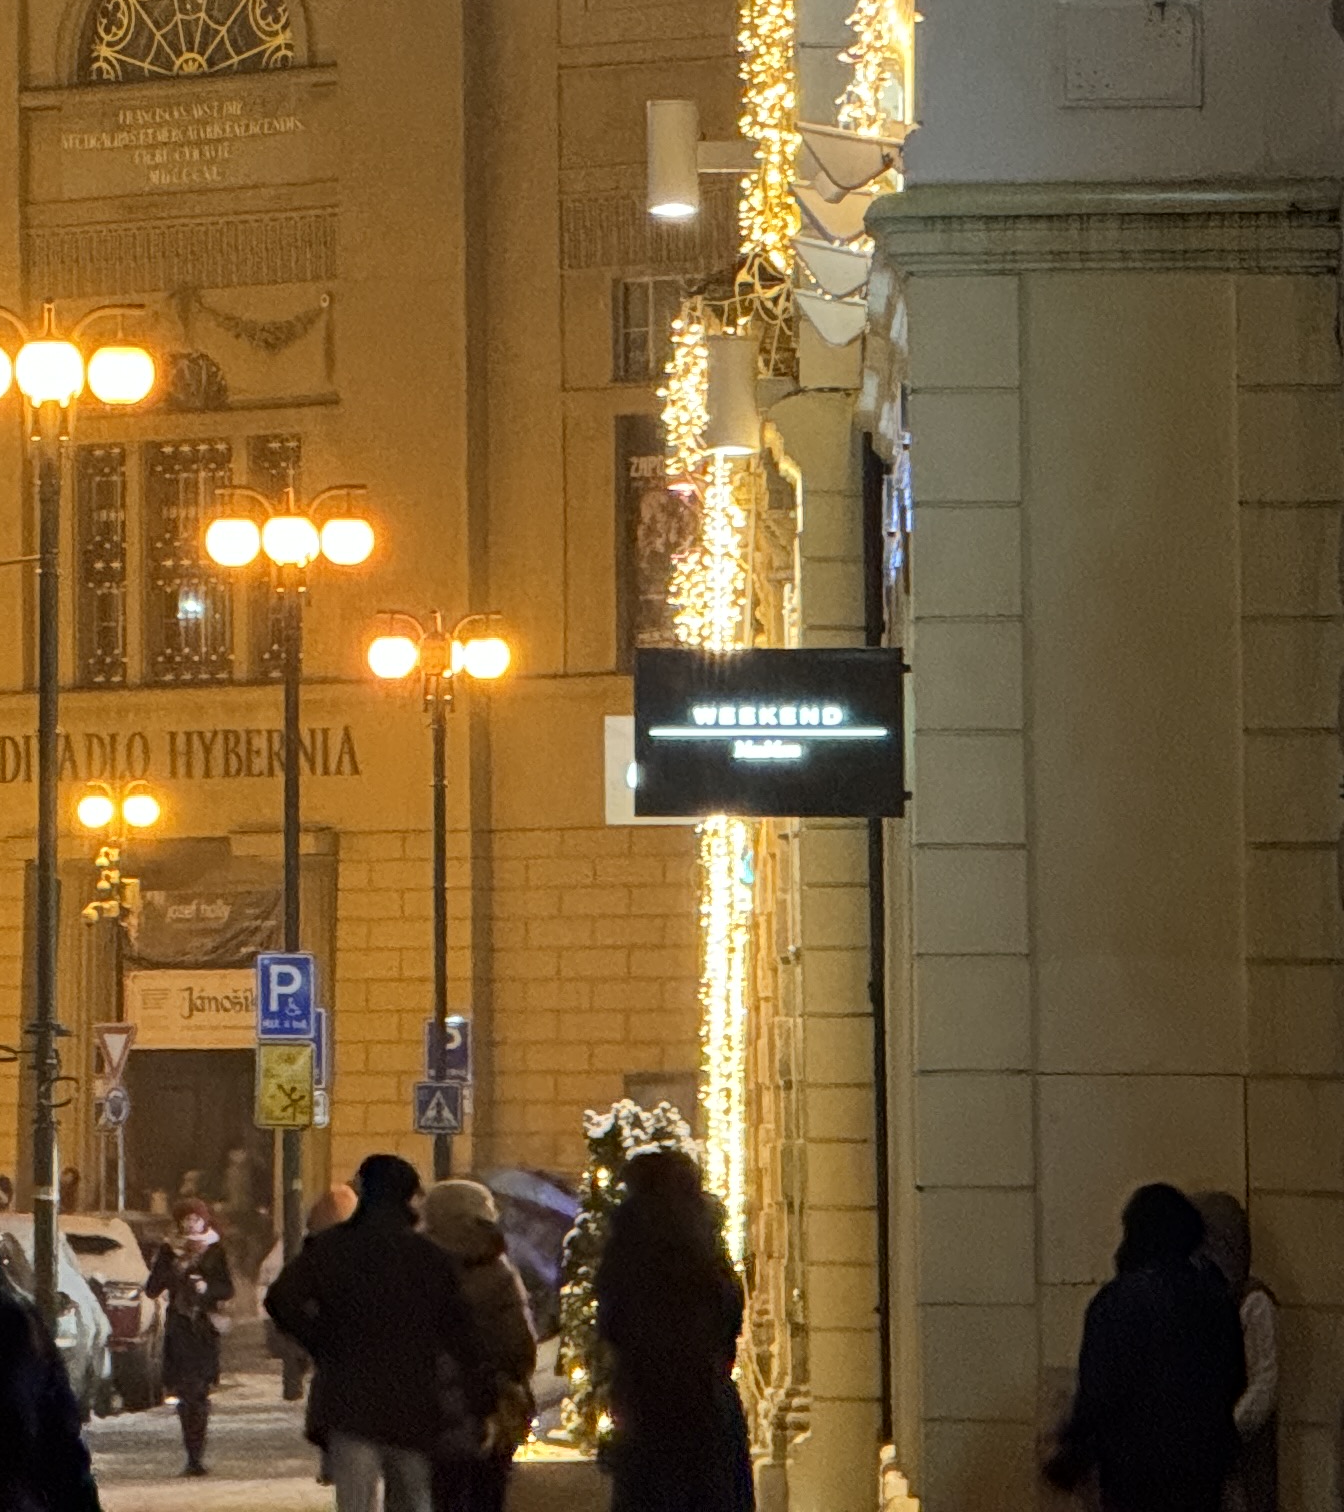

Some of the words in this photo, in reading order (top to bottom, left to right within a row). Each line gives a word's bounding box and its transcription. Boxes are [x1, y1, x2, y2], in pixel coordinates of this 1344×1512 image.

[692, 706, 844, 726] WEEKEND
[166, 724, 362, 779] HYBERNIA
[269, 964, 303, 1013] P
